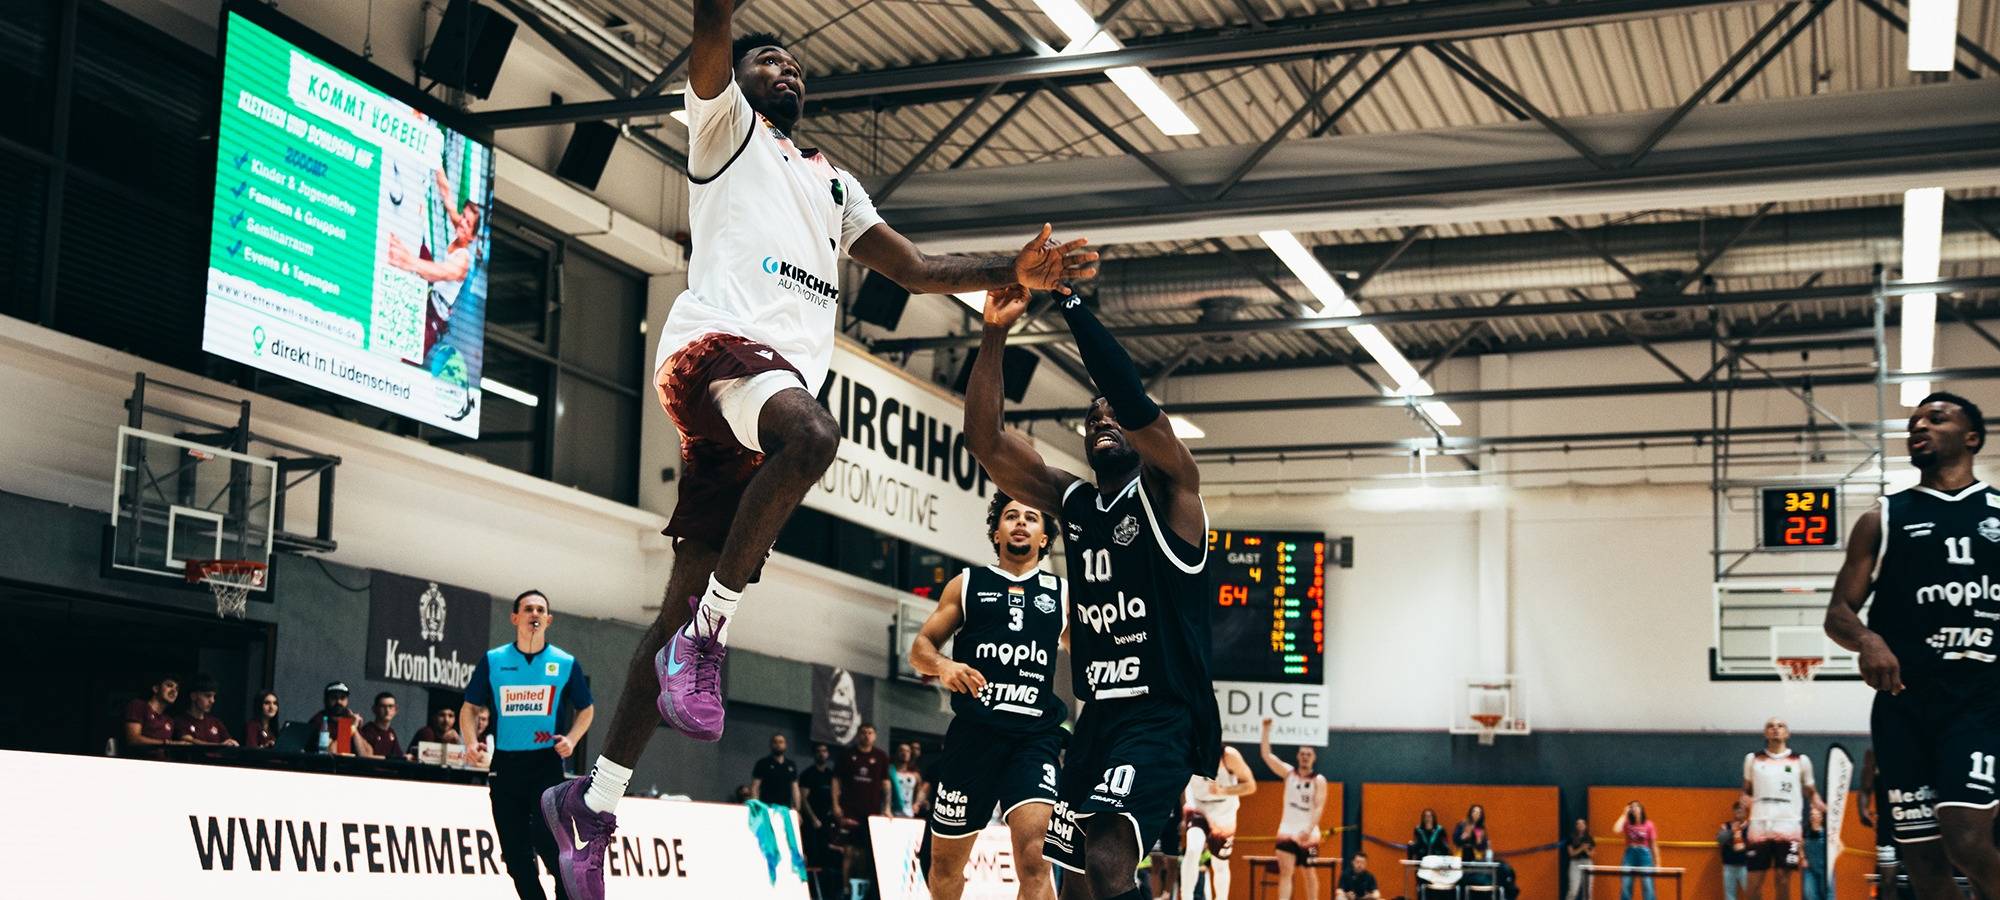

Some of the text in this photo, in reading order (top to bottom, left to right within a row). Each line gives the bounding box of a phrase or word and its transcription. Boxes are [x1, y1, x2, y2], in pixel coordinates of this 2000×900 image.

[308, 74, 365, 121] KOMMT
[251, 159, 356, 217] Kinder & Jugendliche
[248, 187, 347, 240] Familien & Gruppen
[246, 217, 314, 257] Seminarraum
[243, 246, 340, 295] Events & Tagungen
[271, 339, 411, 400] direkt in Lüdenscheid
[1784, 515, 1829, 545] 22
[1082, 548, 1112, 582] 10
[1227, 552, 1261, 564] GAST
[1944, 536, 1976, 566] 11
[1249, 567, 1262, 583] 4
[1218, 585, 1249, 607] 64
[1008, 607, 1024, 632] 3
[385, 638, 477, 690] Krombacher
[976, 640, 1048, 667] mopla
[1090, 656, 1141, 685] TMG
[505, 689, 545, 704] junited
[505, 703, 543, 712] AUTOGLAS
[994, 683, 1040, 705] TMG
[1214, 688, 1320, 718] DICE
[1042, 763, 1056, 787] 3
[1968, 751, 1996, 784] 11
[934, 797, 966, 818] mbH
[1892, 804, 1934, 821] Gmb
